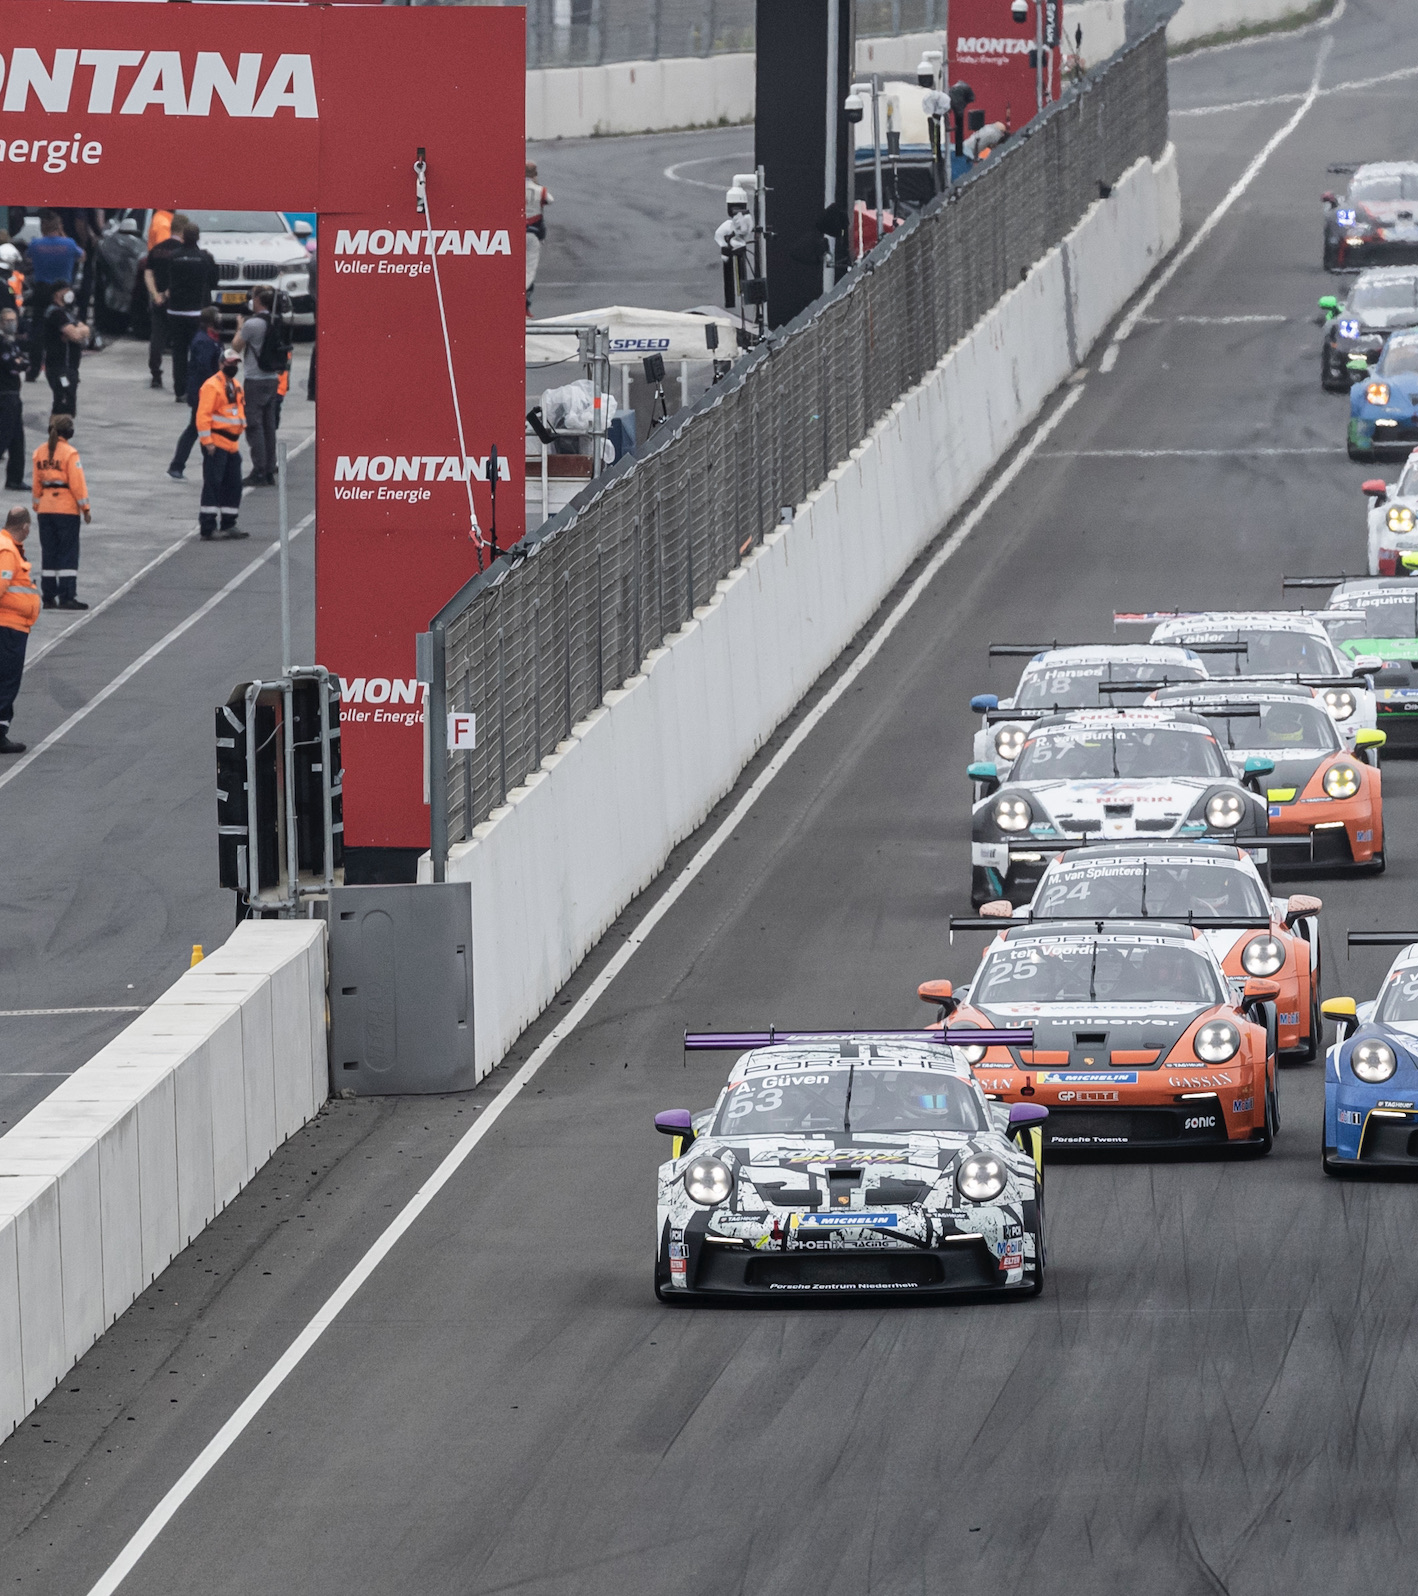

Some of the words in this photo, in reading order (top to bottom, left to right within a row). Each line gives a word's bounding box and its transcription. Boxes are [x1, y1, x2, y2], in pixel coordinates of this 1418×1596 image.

[956, 37, 1037, 55] MONTAN
[0, 47, 319, 118] NTANA
[0, 132, 103, 174] ergie
[333, 229, 512, 255] MONTANA
[334, 260, 376, 274] Voller
[378, 260, 432, 277] Energie
[333, 456, 511, 481] MONTANA
[334, 487, 375, 500] Voller
[376, 487, 431, 503] Energie
[373, 709, 424, 727] Energie
[454, 718, 469, 744] F
[1035, 736, 1050, 748] R.
[1047, 874, 1062, 886] M.
[1063, 870, 1085, 881] van
[1085, 866, 1150, 879] Splunteren
[1045, 881, 1090, 908] 24
[993, 953, 1006, 963] L.
[1010, 947, 1038, 960] ten
[1041, 945, 1100, 956] Voorde
[988, 959, 1038, 987] 25
[1391, 971, 1406, 987] J.
[1051, 1018, 1179, 1027] uniserver
[744, 1058, 957, 1077] PORSCHE
[735, 1080, 756, 1096] A.
[761, 1074, 830, 1090] Güven
[1168, 1072, 1233, 1089] GASSAN
[727, 1088, 784, 1120] 53
[1058, 1091, 1076, 1101] GP
[1076, 1091, 1120, 1101] ELITE
[1184, 1116, 1216, 1130] SONIC
[751, 1148, 943, 1163] IRONFORCE
[820, 1215, 889, 1226] MICHELIN
[769, 1283, 811, 1291] Porsche
[857, 1281, 919, 1289] Niederrhein
